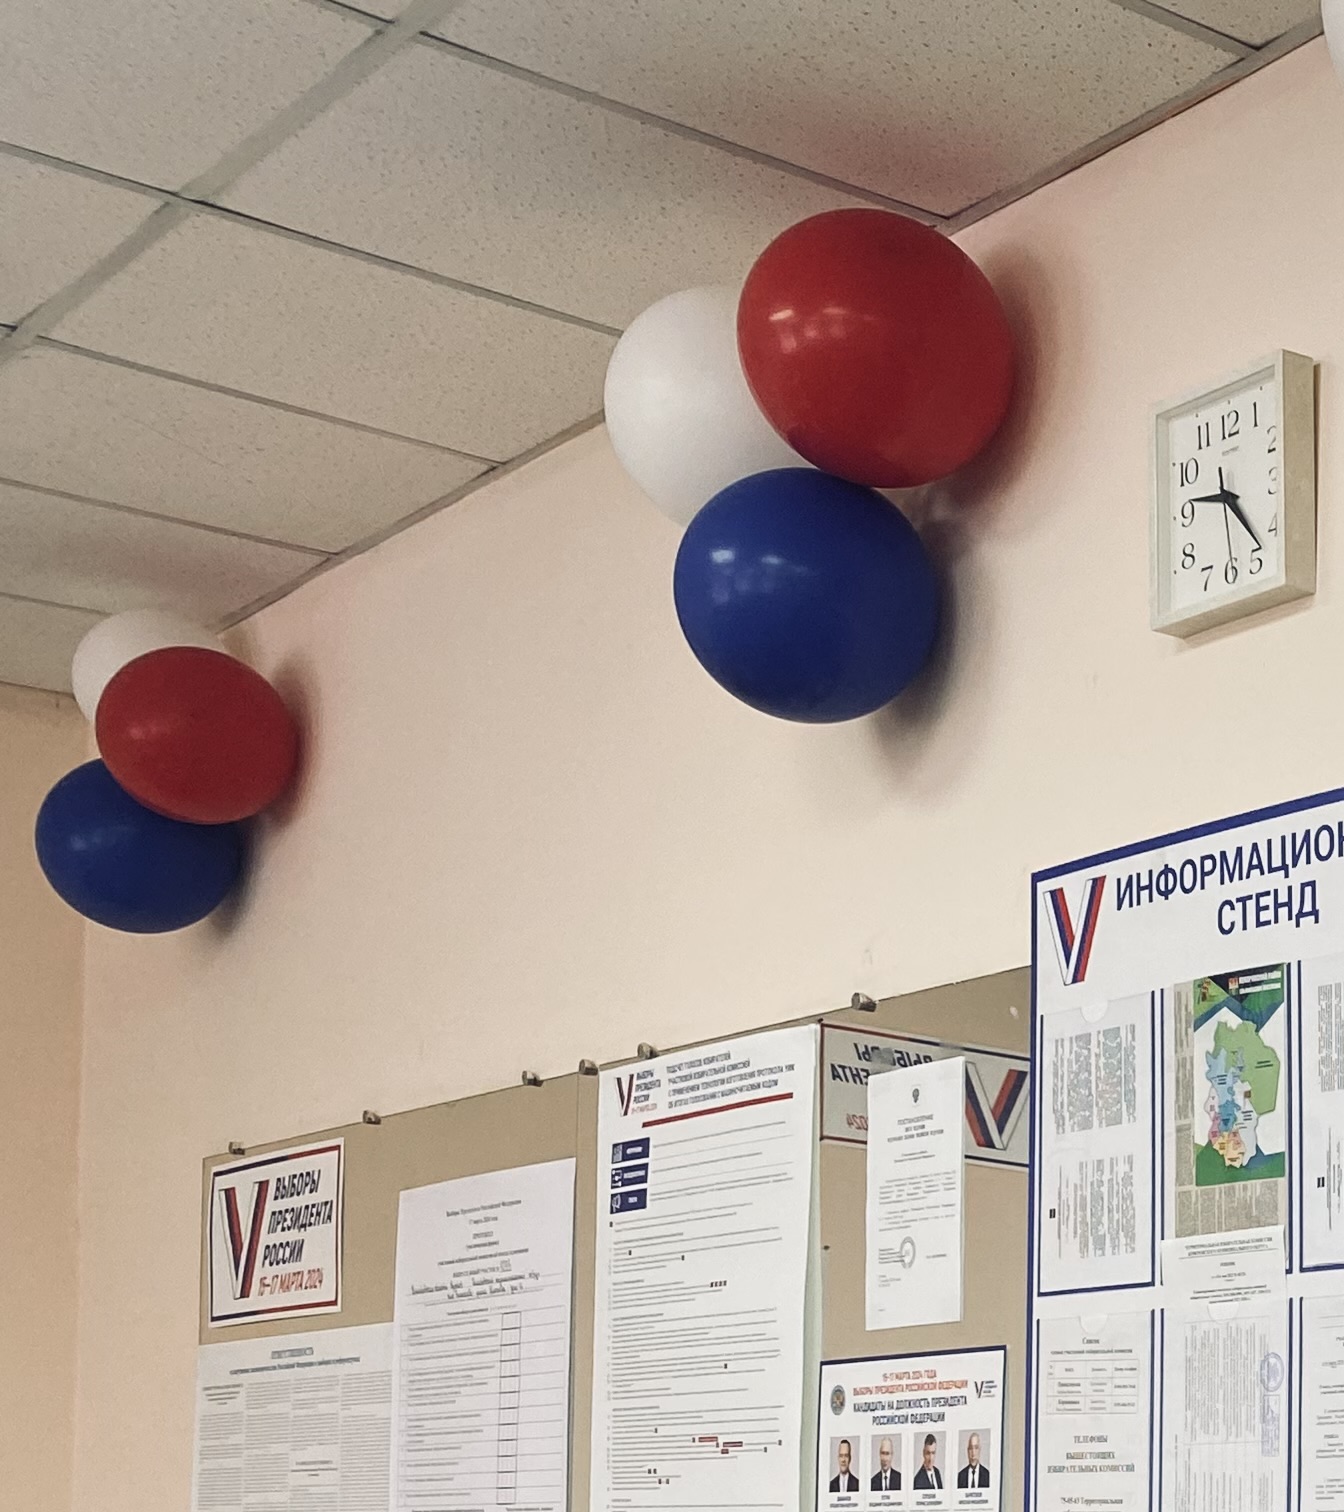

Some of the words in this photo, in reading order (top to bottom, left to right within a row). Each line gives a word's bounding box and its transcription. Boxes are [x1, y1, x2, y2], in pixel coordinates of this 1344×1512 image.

[1221, 410, 1240, 440] 12
[1253, 402, 1259, 427] 1
[1198, 422, 1211, 450] 11
[1267, 426, 1277, 453] 2
[1179, 458, 1199, 487] 10
[1268, 467, 1278, 495] 3
[1181, 500, 1195, 527] 9
[1268, 512, 1278, 536] 4
[1182, 544, 1195, 569] 8
[1249, 548, 1263, 574] 5
[1201, 566, 1213, 591] 7
[1224, 557, 1237, 584] 6
[1218, 880, 1320, 936] СТЕНД
[274, 1169, 321, 1201] ВЫБОРЫ
[268, 1200, 333, 1234] ПРЕЗИДЕНТА
[262, 1239, 304, 1268] РОССИИ
[280, 1271, 304, 1293] МАРТА
[304, 1268, 324, 1290] 2024
